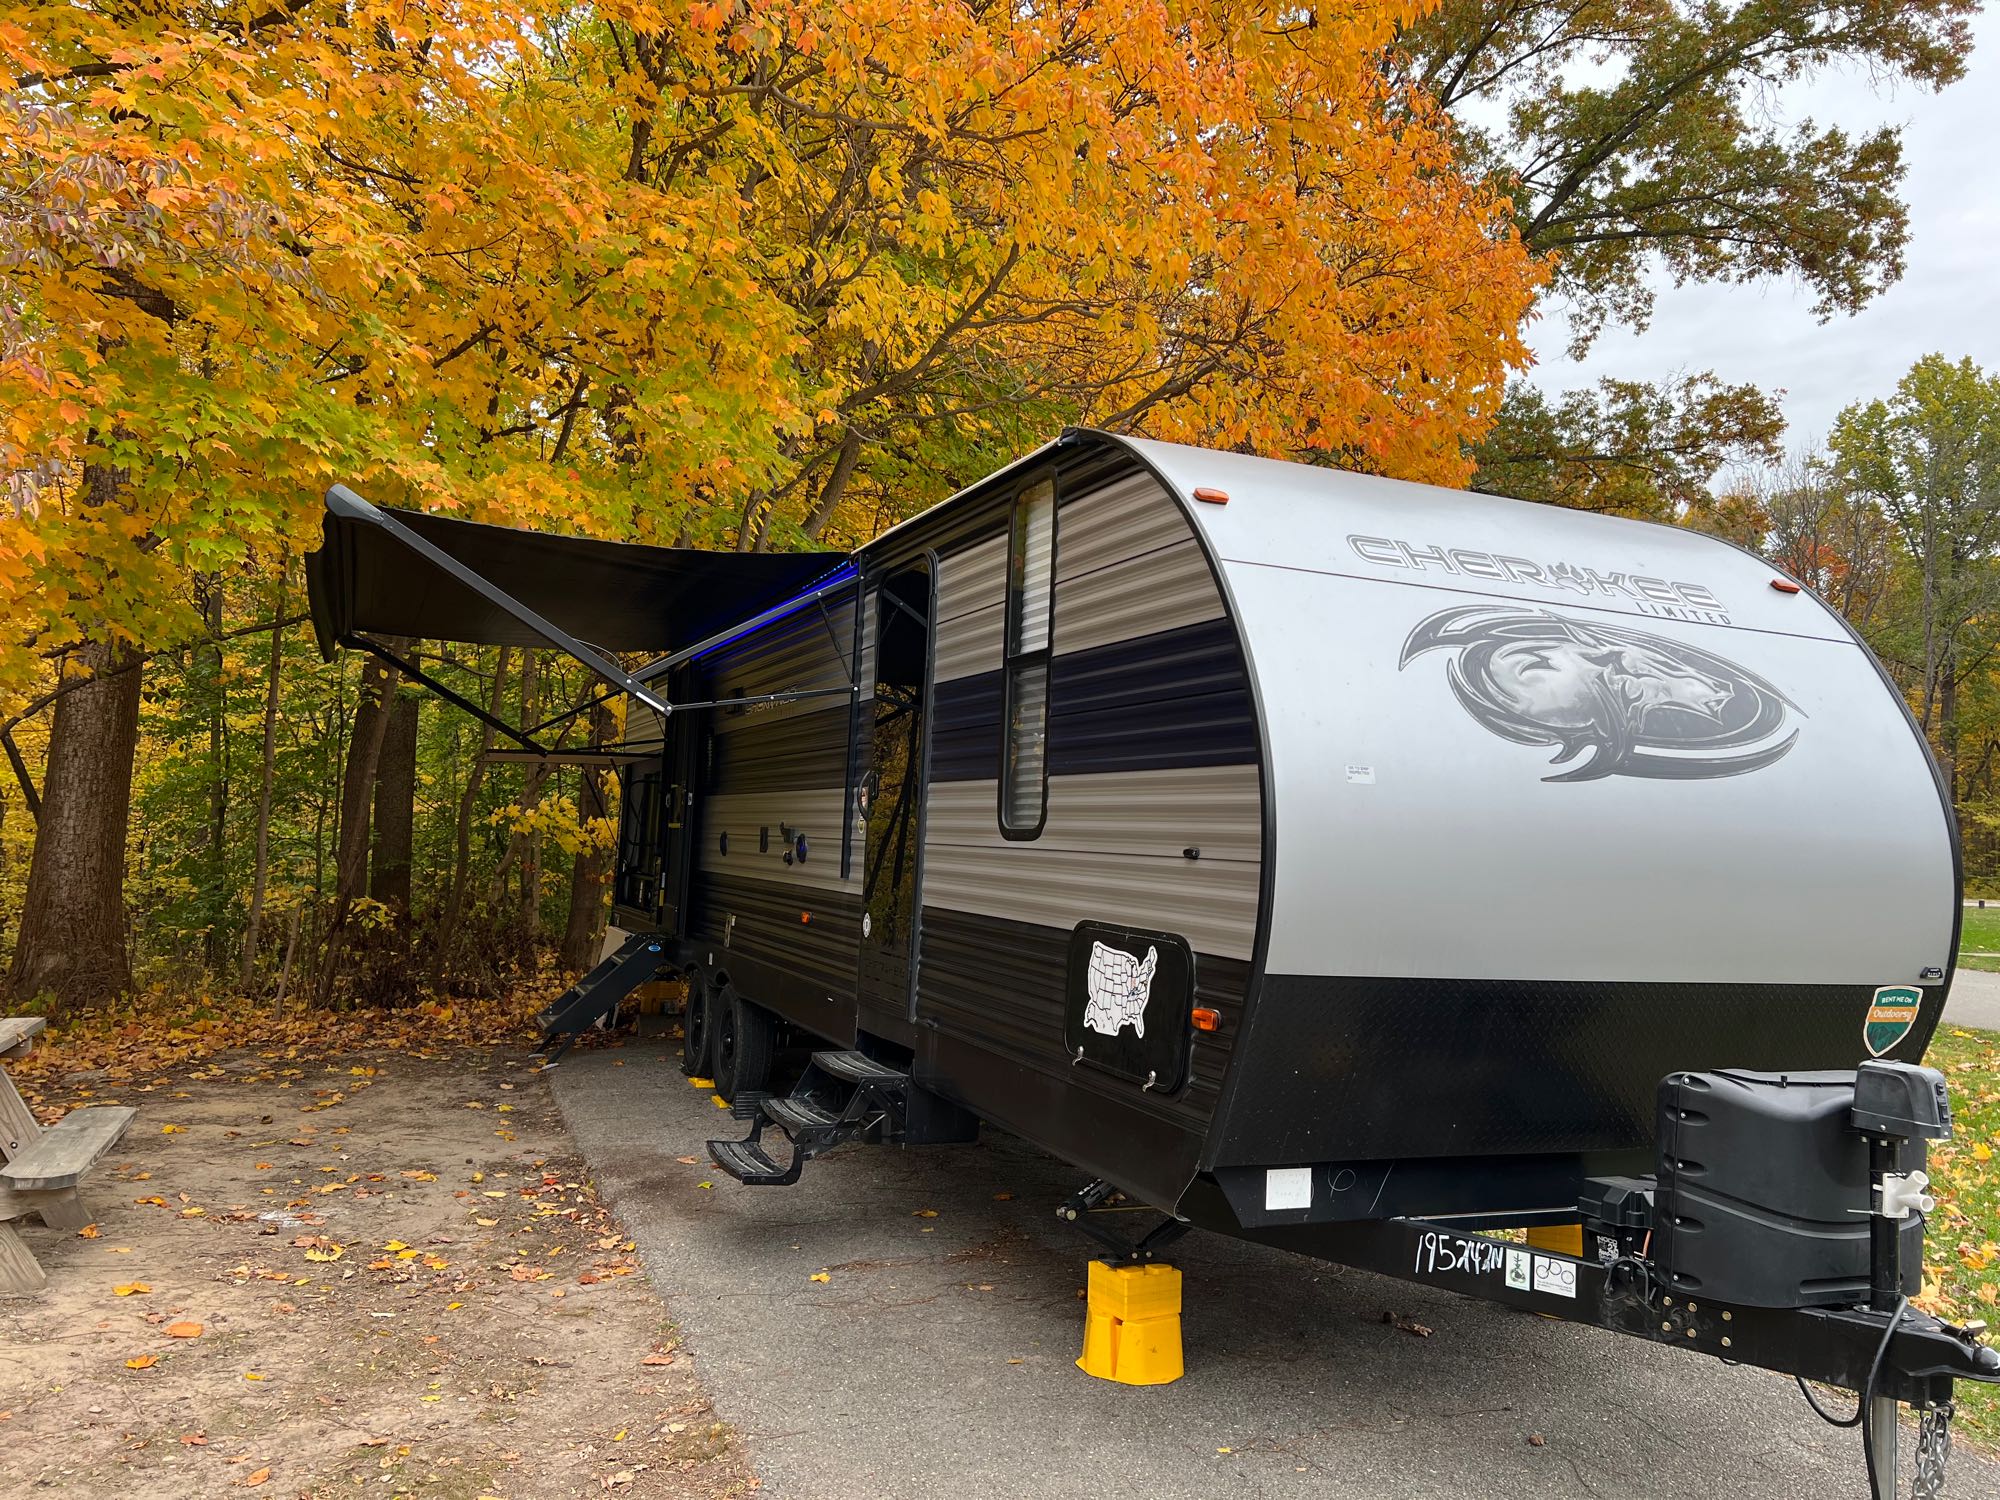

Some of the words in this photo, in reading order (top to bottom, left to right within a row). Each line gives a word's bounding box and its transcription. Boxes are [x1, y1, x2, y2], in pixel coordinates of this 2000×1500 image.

[1635, 602, 1731, 625] LIMITED
[1882, 996, 1896, 1004] RENT
[1873, 1008, 1913, 1022] Outdoorsy
